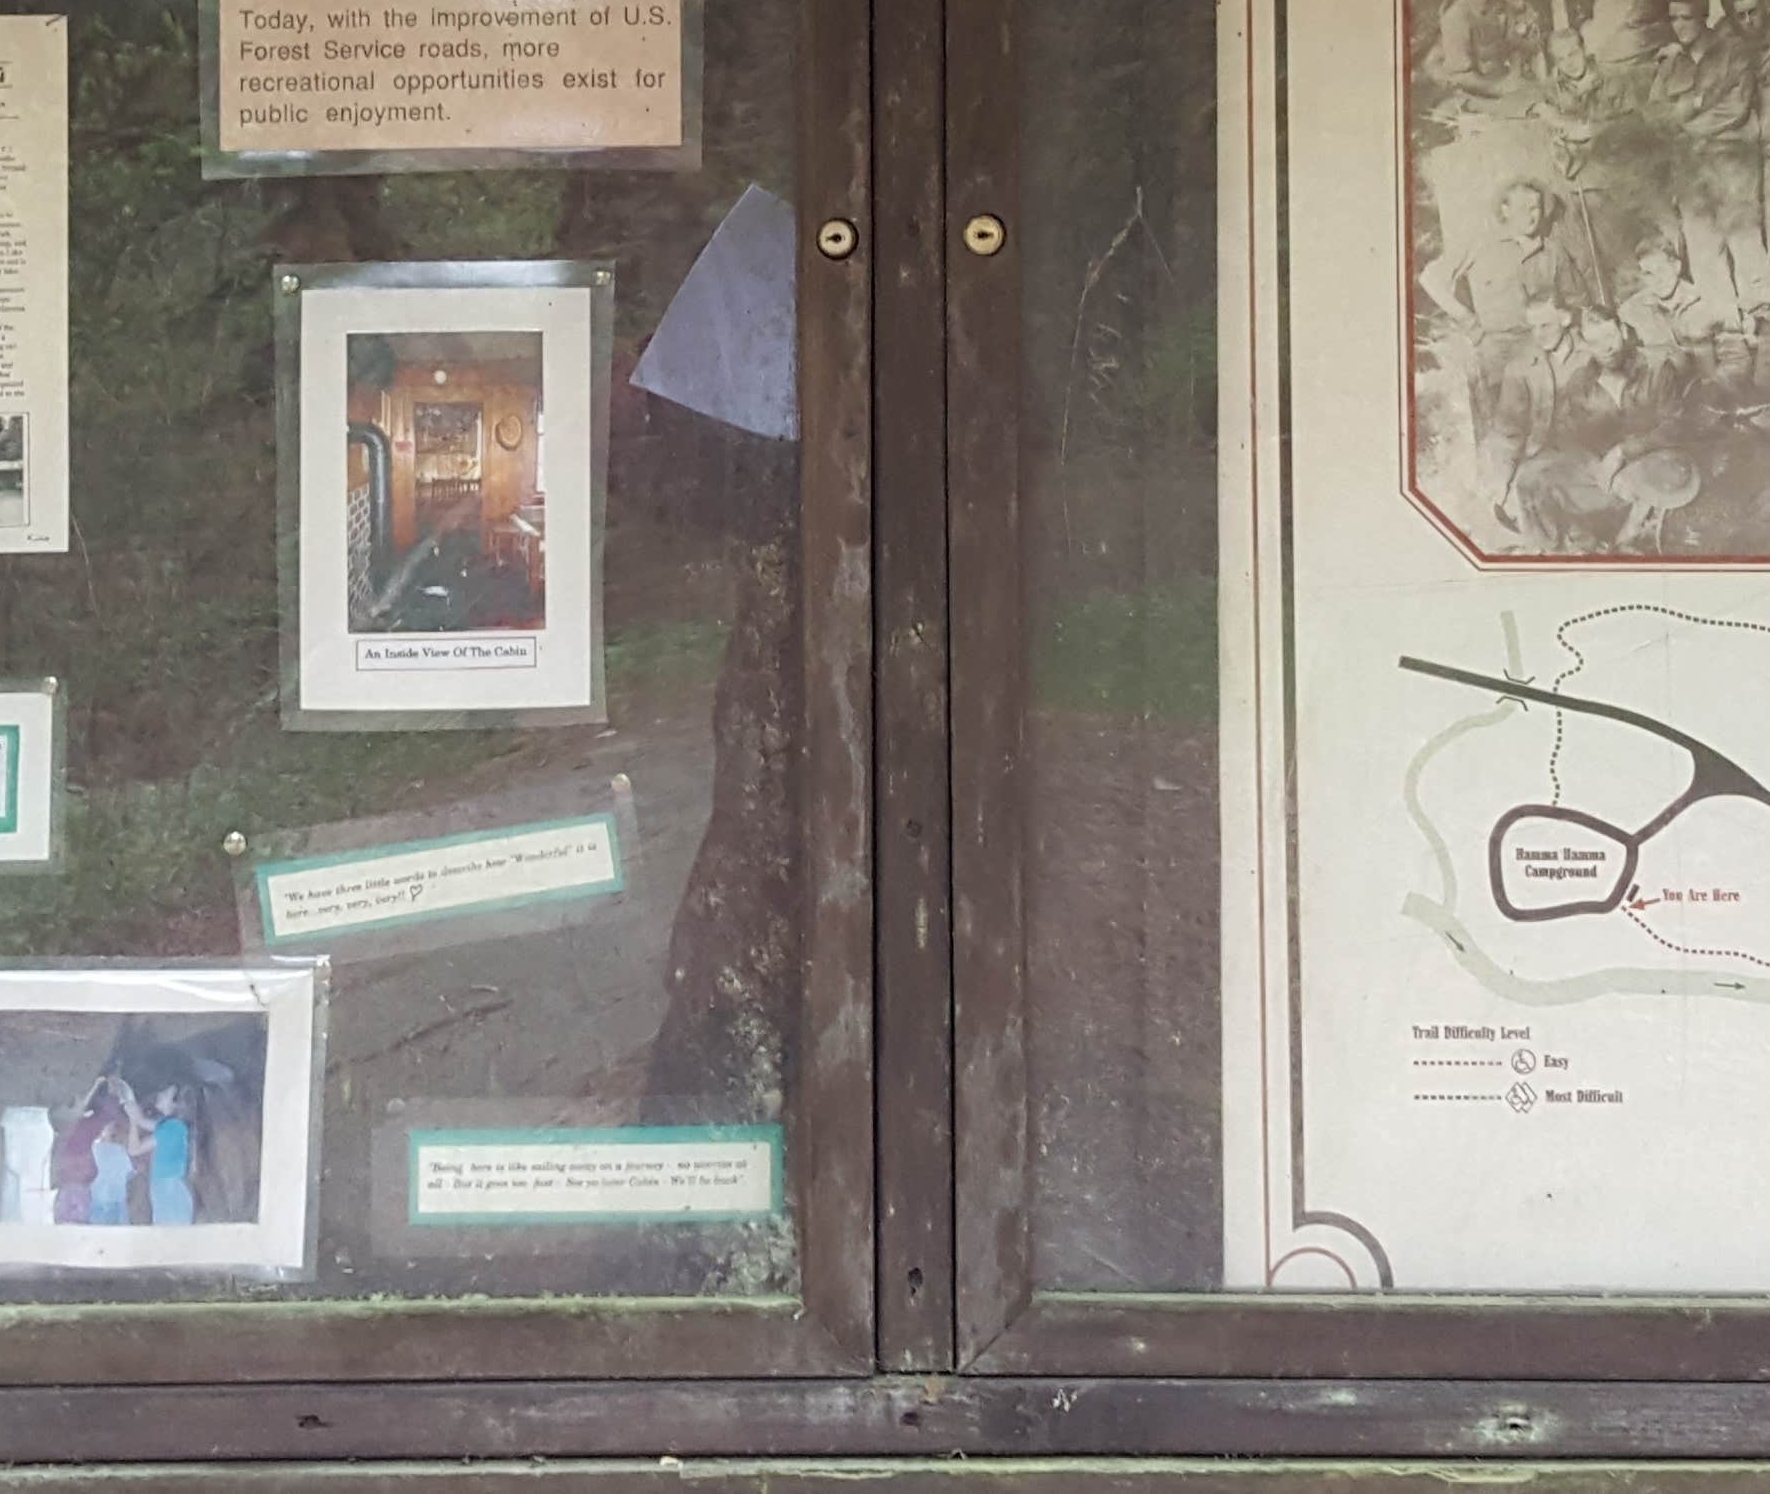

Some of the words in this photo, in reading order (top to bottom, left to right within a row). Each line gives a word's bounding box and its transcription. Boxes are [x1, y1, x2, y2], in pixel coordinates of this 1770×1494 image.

[239, 39, 311, 62] Forest
[323, 38, 406, 60] Service
[418, 37, 489, 61] roads,
[501, 38, 560, 59] more
[239, 69, 375, 93] recreational
[392, 65, 544, 96] opportunities
[561, 67, 617, 89] exist
[634, 66, 666, 89] for
[239, 103, 310, 127] public
[324, 98, 451, 128] enjoyment.
[364, 648, 381, 659] An
[384, 647, 419, 659] Inside
[421, 646, 450, 658] View
[452, 645, 468, 658] Of
[468, 645, 492, 658] The
[493, 645, 527, 657] Cabin
[1515, 847, 1559, 861] Hamma
[1562, 847, 1606, 861] Hamma
[1524, 863, 1597, 880] Campground
[1662, 887, 1683, 903] You
[1687, 887, 1708, 902] Are
[1712, 887, 1740, 902] Here
[1411, 1024, 1440, 1039] Trail
[1443, 1025, 1496, 1042] Difficulty
[1499, 1025, 1531, 1040] Level
[1543, 1054, 1569, 1071] Easy
[1544, 1089, 1572, 1103] Most
[1576, 1089, 1623, 1104] Difficult
